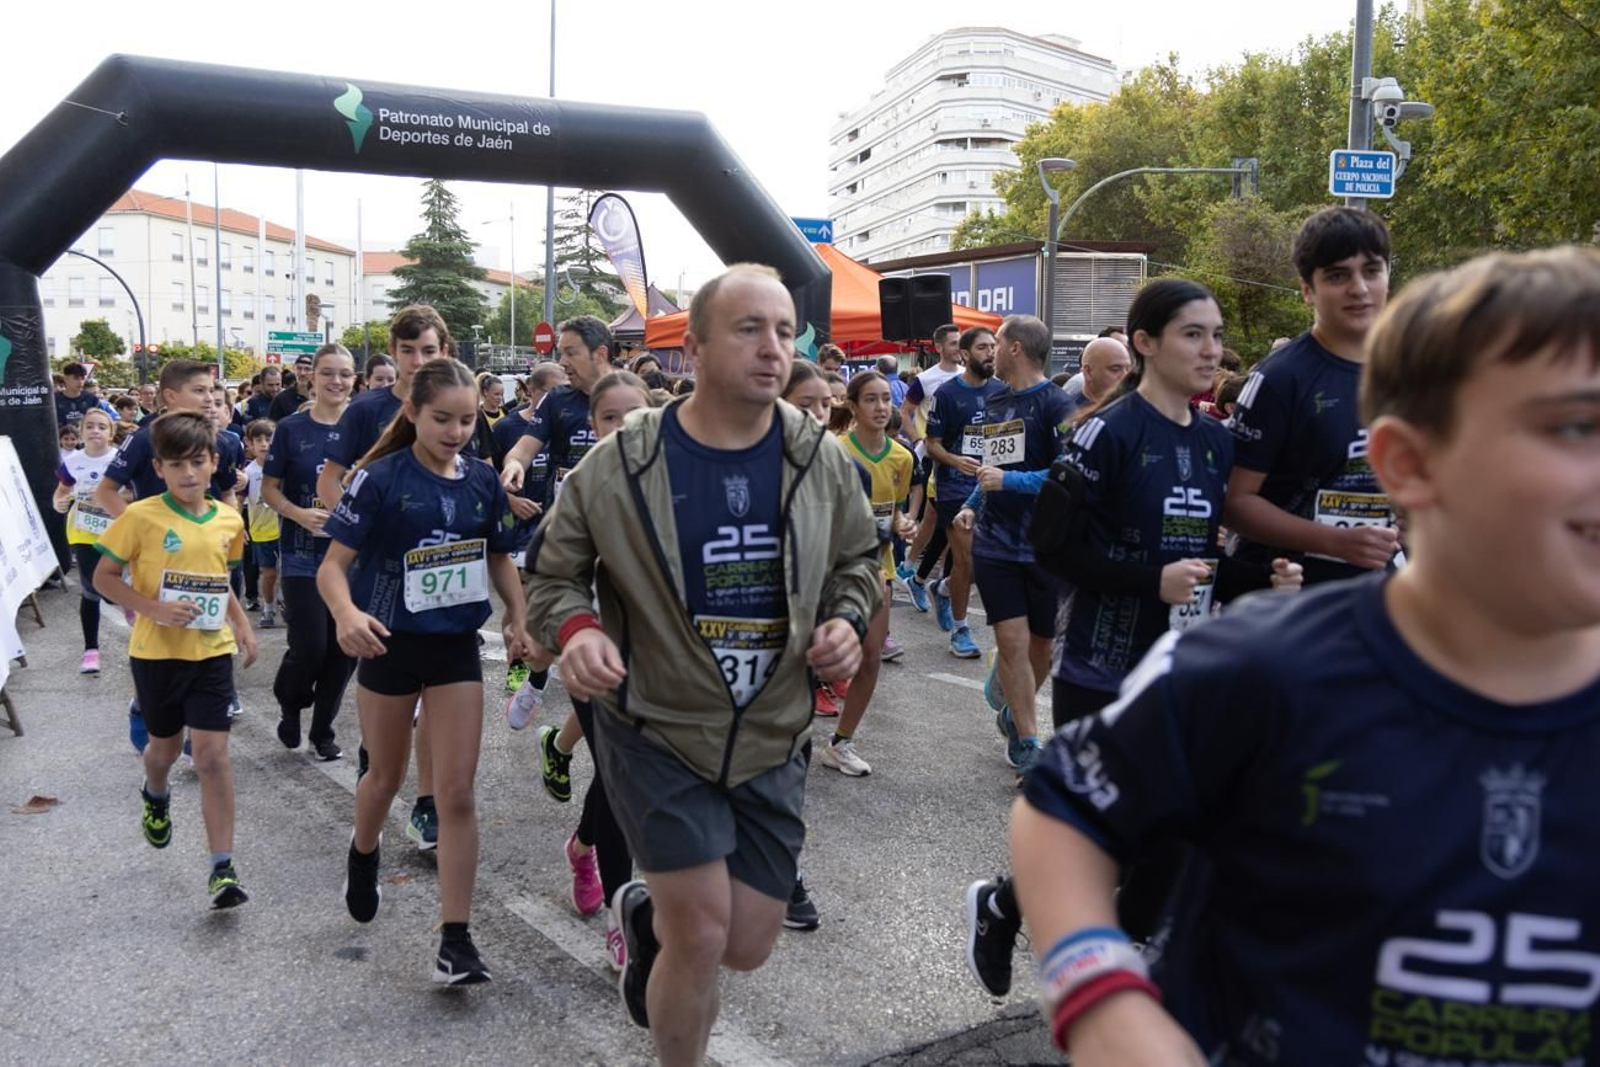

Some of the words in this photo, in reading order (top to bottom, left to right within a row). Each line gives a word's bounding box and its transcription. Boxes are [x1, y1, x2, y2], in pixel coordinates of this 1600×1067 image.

[379, 108, 454, 128] Patronato
[458, 115, 529, 136] Municipal
[533, 122, 551, 136] de
[379, 126, 450, 145] Deportes
[454, 133, 474, 147] de
[477, 134, 513, 150] Jaén
[1350, 155, 1374, 168] Plaza
[1376, 156, 1390, 169] del
[1334, 171, 1360, 182] CUERPO
[1361, 172, 1391, 183] NACIONAL
[1344, 182, 1354, 192] DE
[990, 437, 1016, 456] 283
[1163, 486, 1212, 519] 25
[703, 524, 781, 564] 25
[166, 573, 186, 584] XXV
[703, 561, 781, 577] CARRERA
[421, 566, 467, 595] 971
[700, 621, 727, 638] XXV
[1375, 909, 1600, 1009] 25
